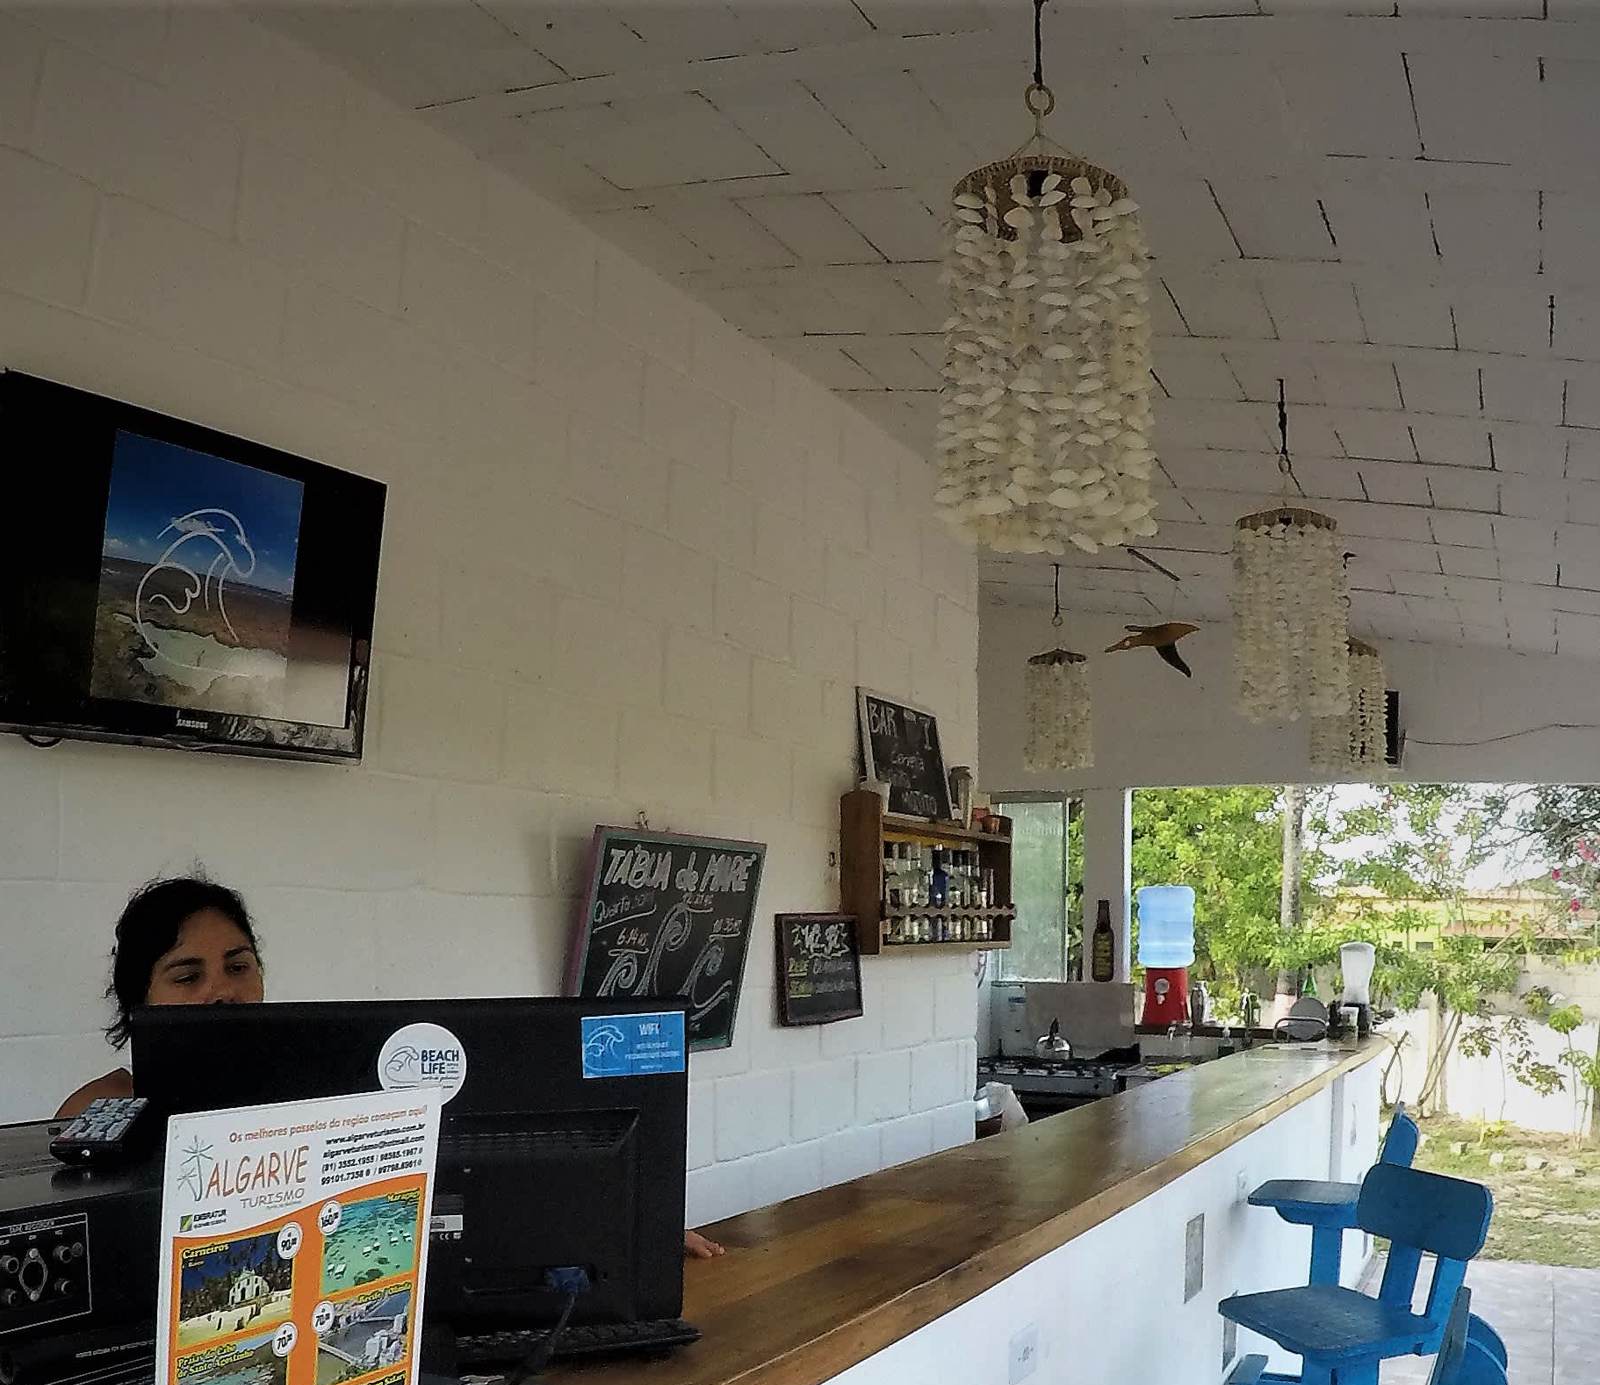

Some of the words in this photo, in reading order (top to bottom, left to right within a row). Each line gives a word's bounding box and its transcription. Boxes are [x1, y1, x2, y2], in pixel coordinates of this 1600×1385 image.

[868, 702, 898, 738] BAR
[421, 1049, 459, 1062] BEACH
[421, 1062, 446, 1074] LIFE
[229, 1132, 242, 1143] Os
[245, 1127, 288, 1140] melhores
[289, 1119, 327, 1137] passeios
[205, 1145, 310, 1199] ALGARVE
[240, 1188, 305, 1209] TURISMO
[182, 1243, 230, 1260] Carneiros
